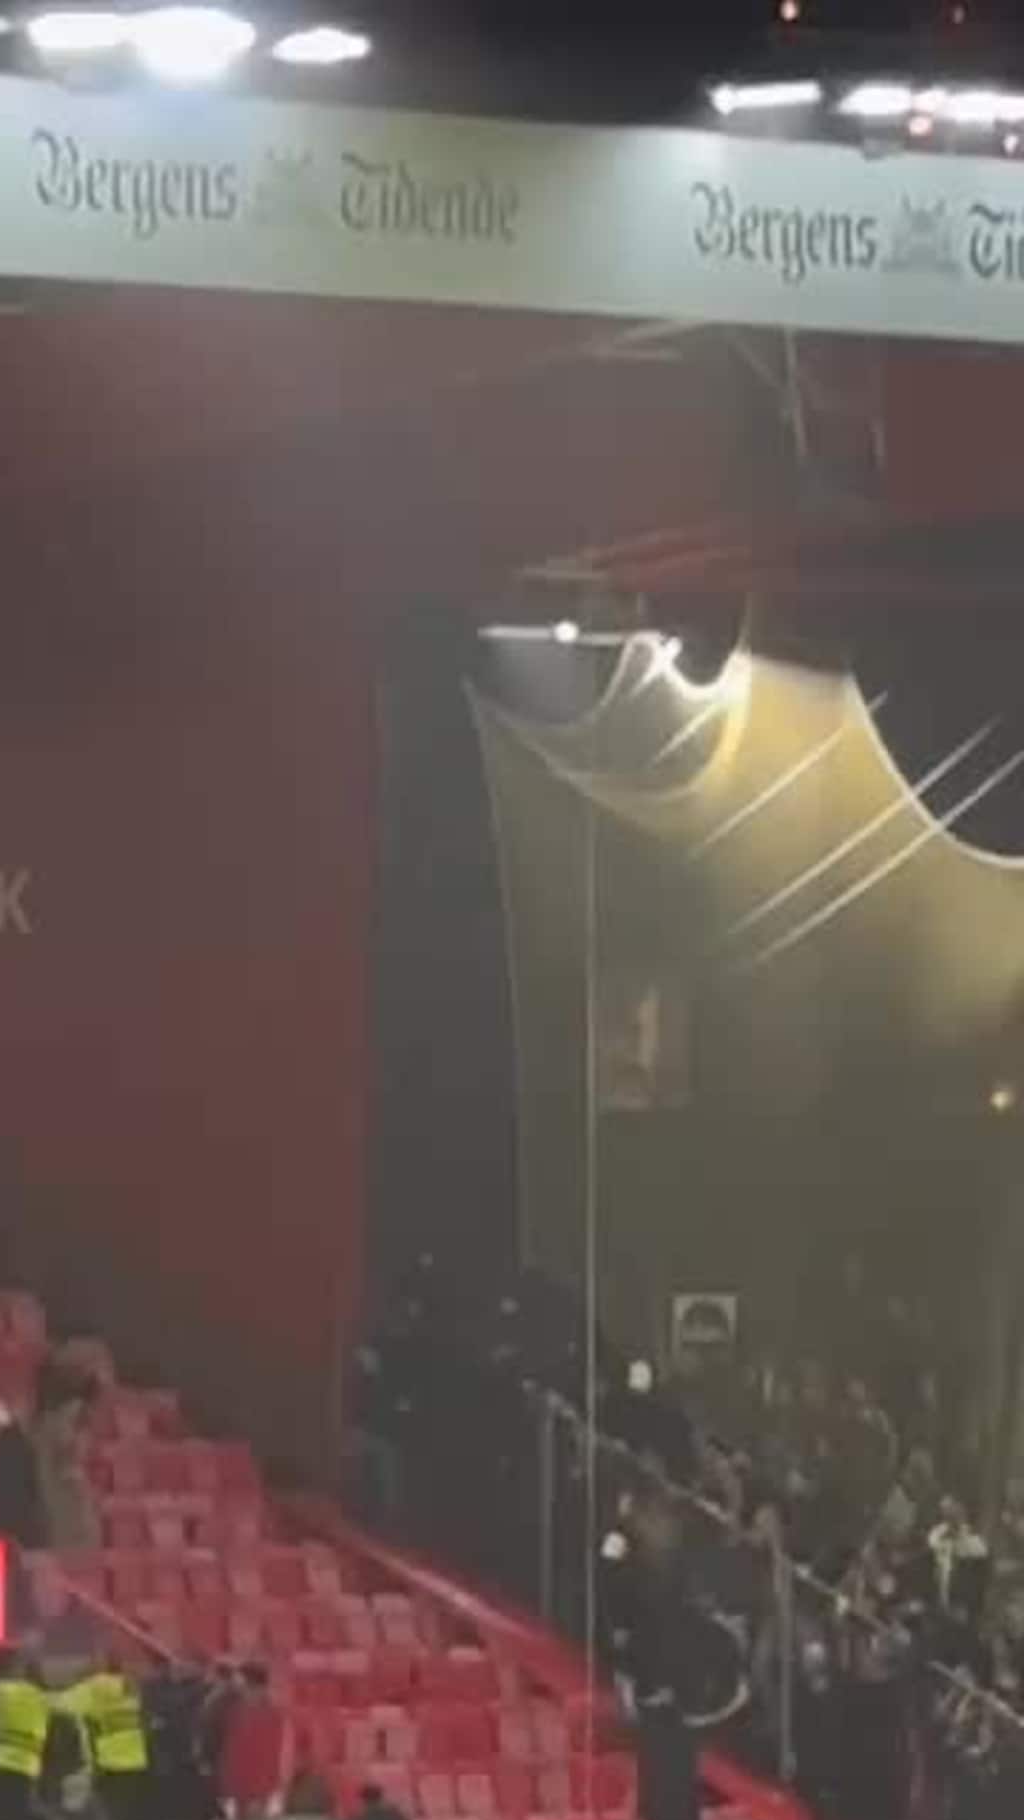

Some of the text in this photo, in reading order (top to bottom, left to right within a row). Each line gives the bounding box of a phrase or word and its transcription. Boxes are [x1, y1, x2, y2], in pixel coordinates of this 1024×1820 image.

[32, 127, 522, 246] Bergens Tidende
[691, 181, 878, 286] Bergens
